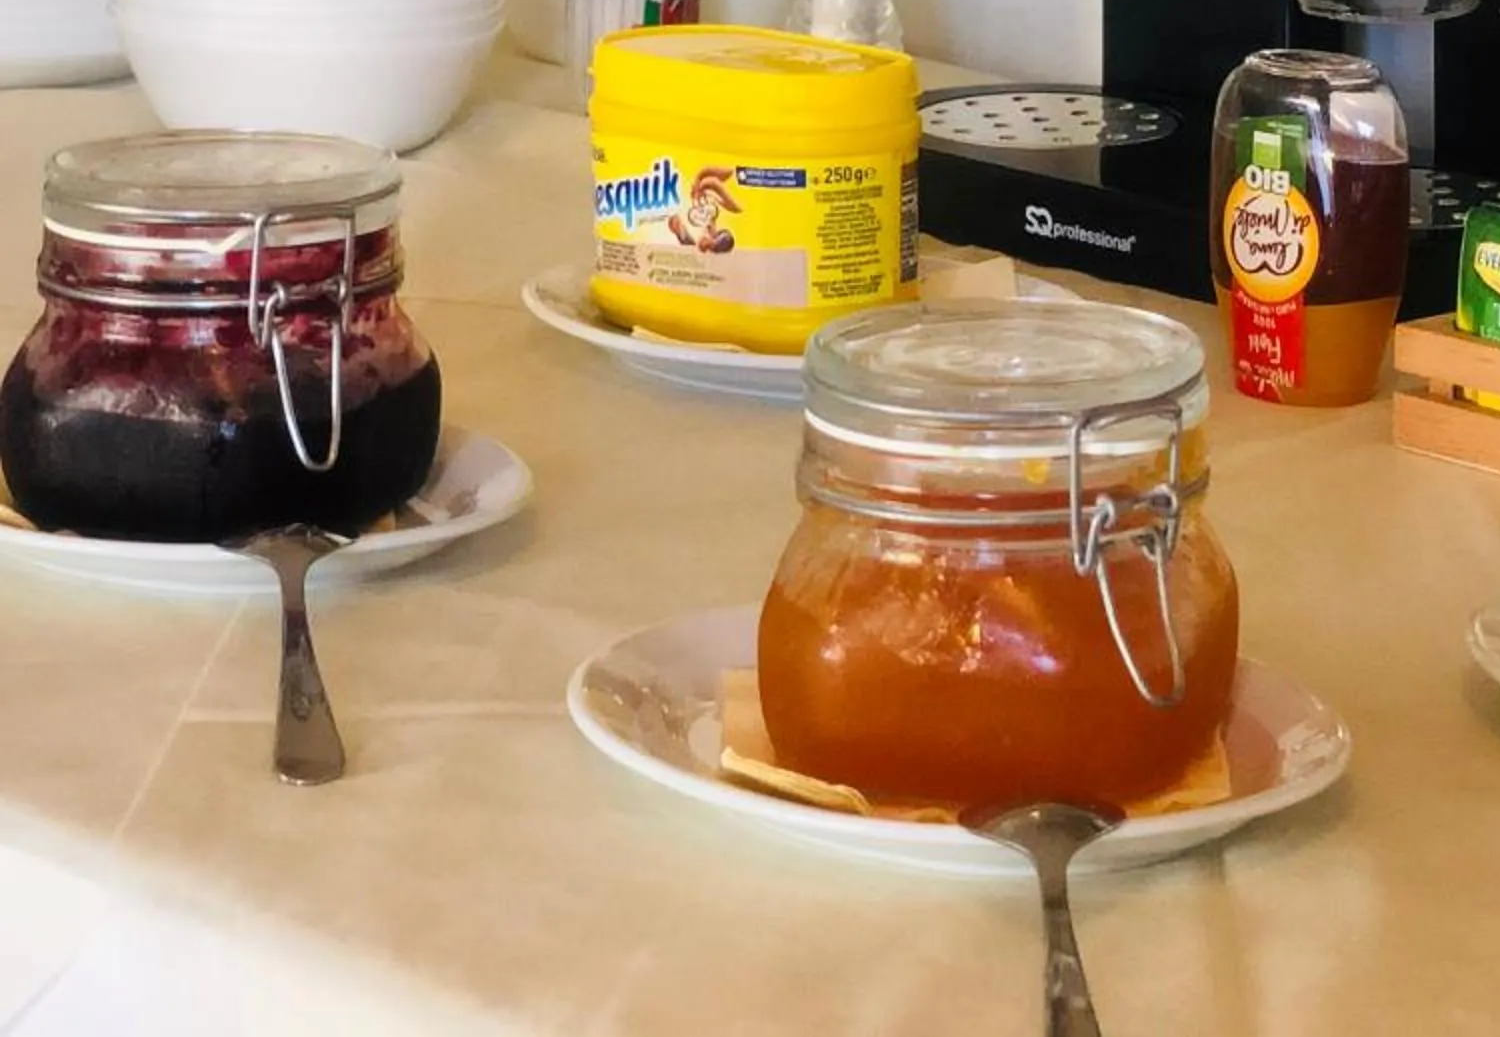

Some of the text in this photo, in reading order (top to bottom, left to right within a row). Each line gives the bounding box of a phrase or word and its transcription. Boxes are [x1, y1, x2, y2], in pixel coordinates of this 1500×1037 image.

[594, 159, 681, 229] esquik
[1244, 164, 1291, 196] BIO
[1024, 204, 1053, 237] SQ
[1291, 213, 1311, 235] di
